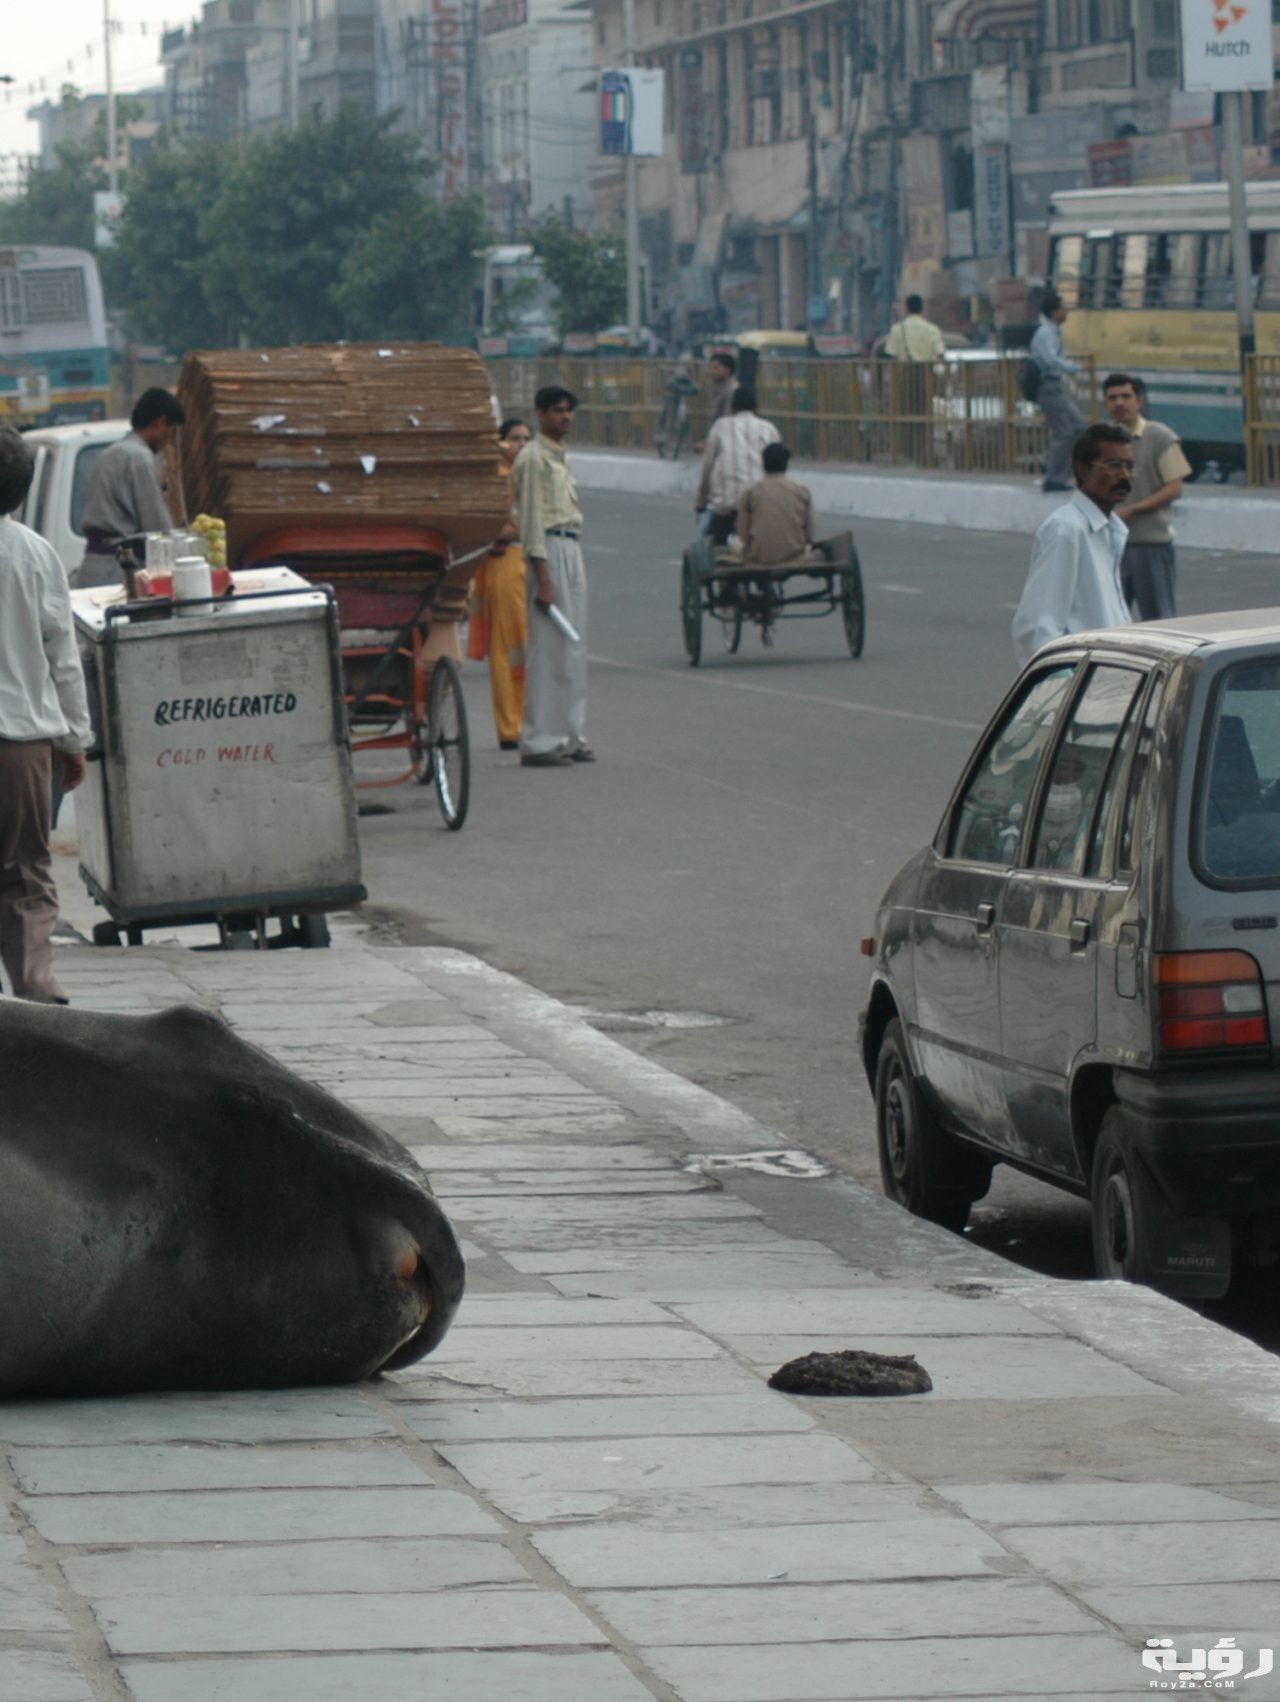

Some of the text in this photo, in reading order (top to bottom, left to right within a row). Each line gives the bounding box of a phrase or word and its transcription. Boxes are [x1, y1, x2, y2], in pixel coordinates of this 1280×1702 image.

[154, 693, 297, 726] REFRIGERATED
[156, 742, 277, 768] COLD WATER
[1167, 1256, 1216, 1268] MARUTI
